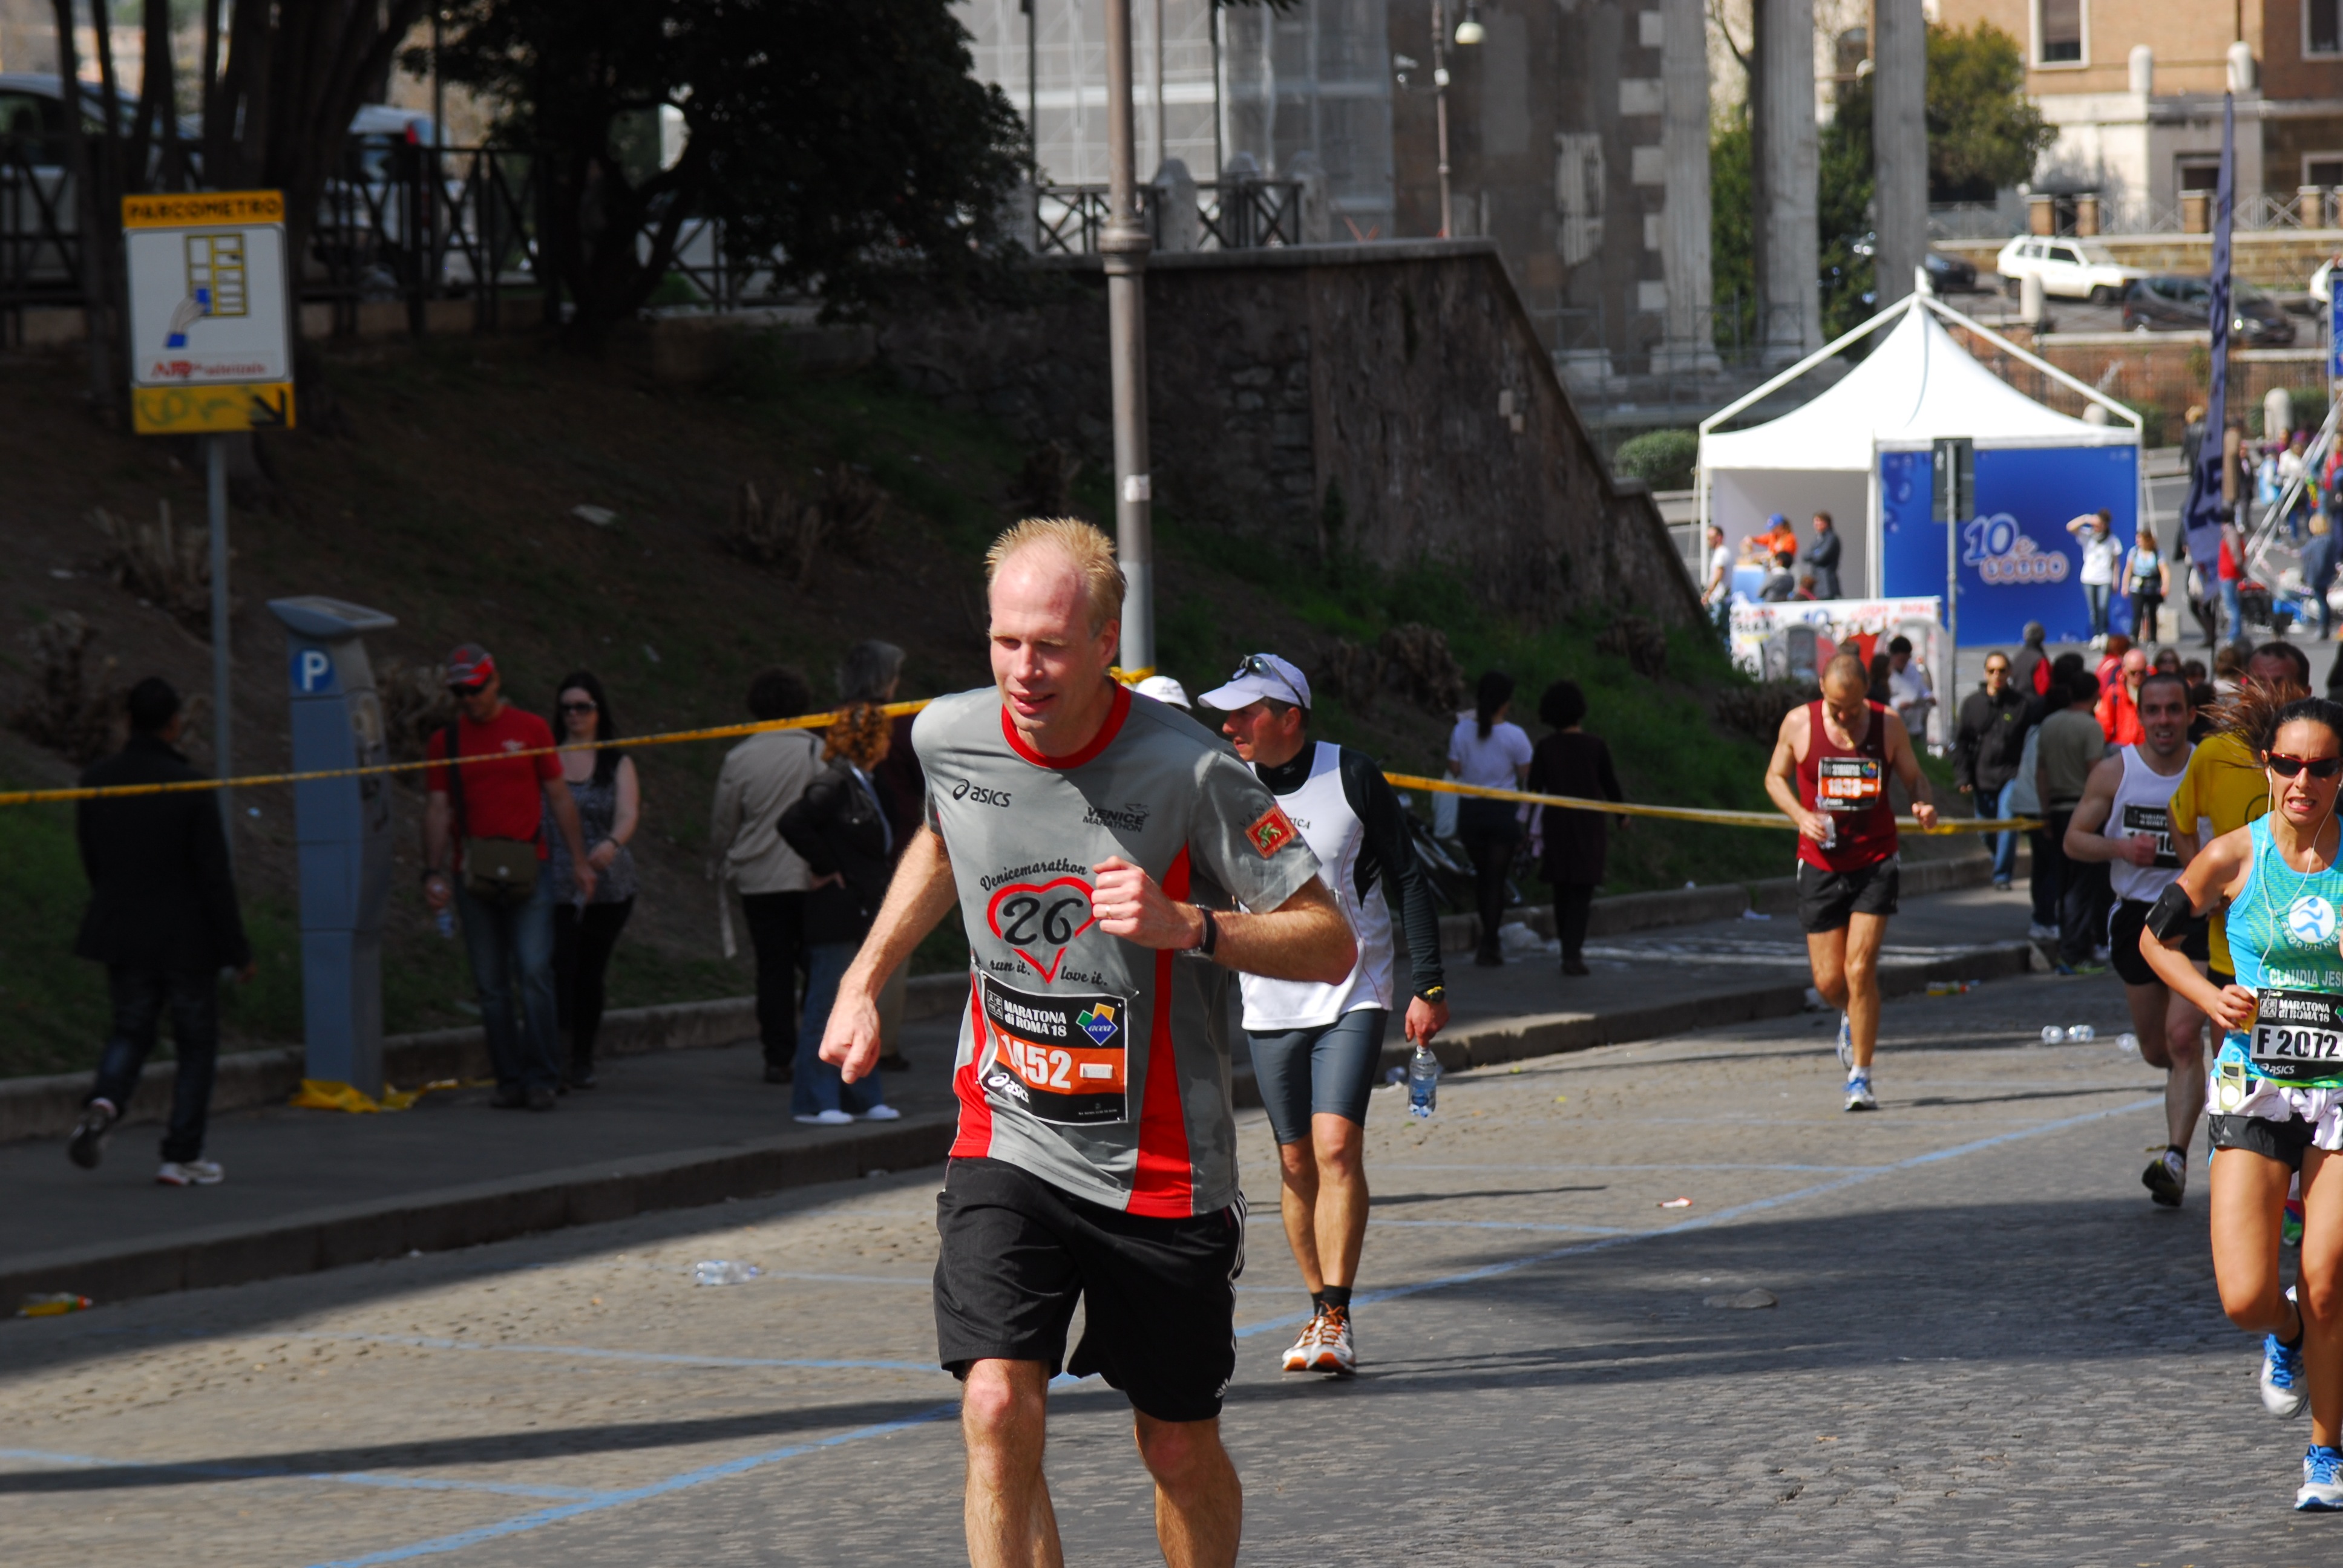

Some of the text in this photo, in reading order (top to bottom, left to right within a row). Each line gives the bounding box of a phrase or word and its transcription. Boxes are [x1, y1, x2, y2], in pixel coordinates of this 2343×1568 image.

[129, 198, 280, 220] PARCOMETRO
[1964, 514, 2019, 564] 10
[303, 650, 329, 691] P
[969, 786, 1011, 808] asics
[1083, 815, 1143, 832] MARATHON
[1087, 806, 1145, 825] VENICE
[980, 858, 1088, 891] Venicemarathon
[1003, 897, 1084, 946] 26
[989, 959, 1031, 976] run it.
[1061, 965, 1107, 986] love it.
[2269, 969, 2343, 987] CLAUDIA JES
[1004, 999, 1067, 1024] MARATONA
[2279, 999, 2330, 1013] MARATONA
[2289, 1010, 2318, 1021] ROMA
[1004, 1012, 1015, 1024] di
[1016, 1014, 1049, 1034] ROMA
[2256, 1027, 2340, 1059] F 2072
[1004, 1080, 1029, 1103] asics
